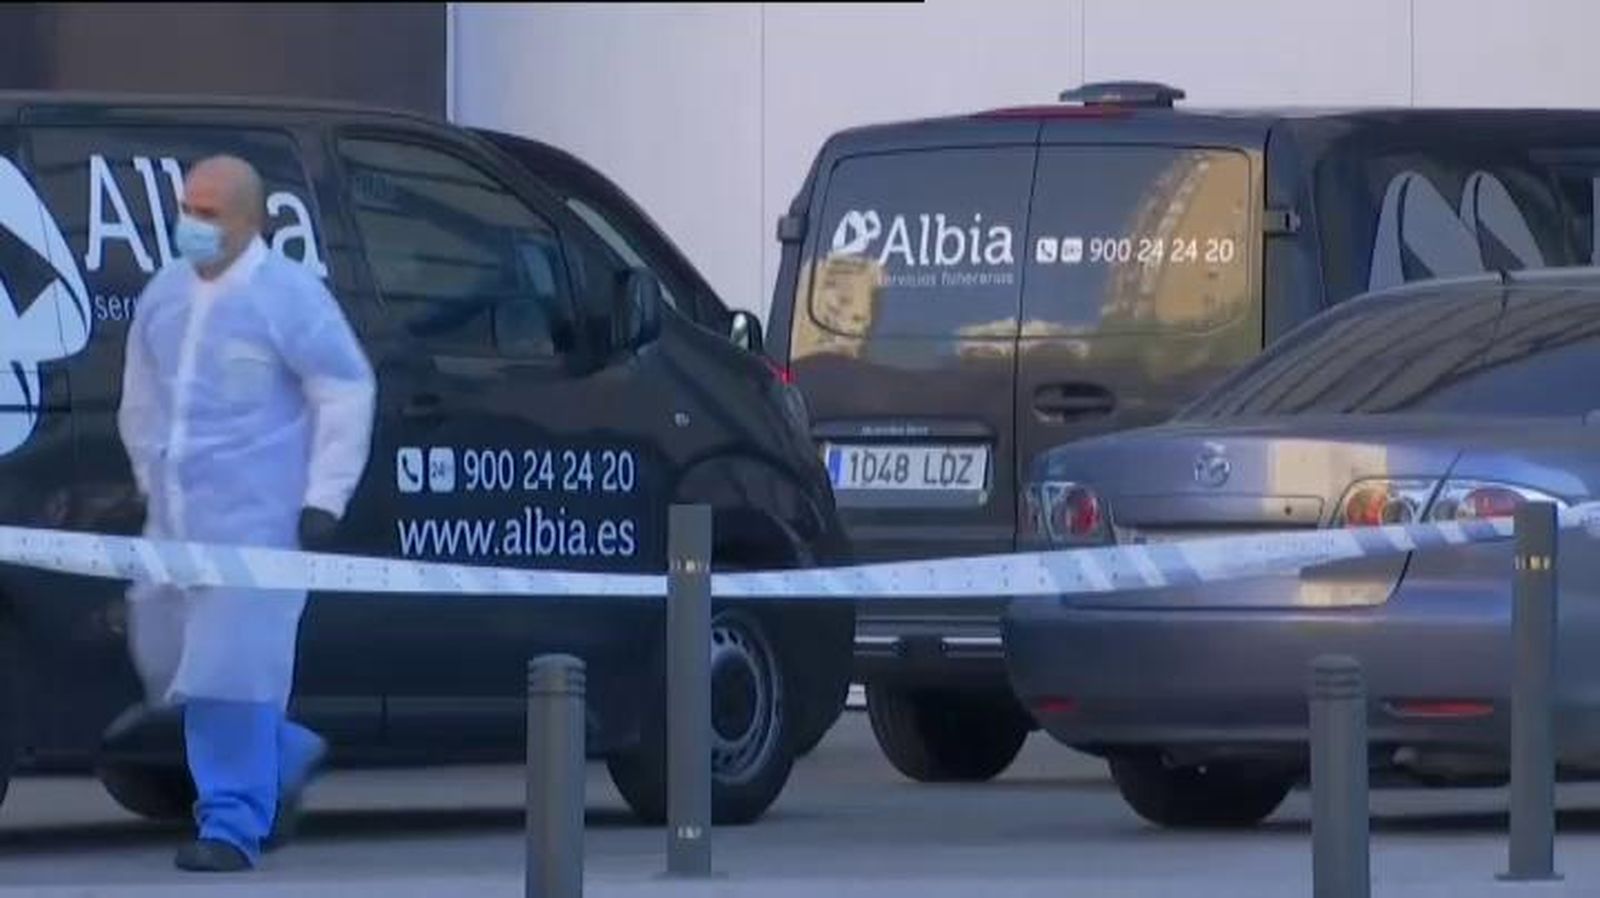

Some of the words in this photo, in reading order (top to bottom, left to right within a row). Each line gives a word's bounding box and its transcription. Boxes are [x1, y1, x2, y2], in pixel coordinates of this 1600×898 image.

[85, 154, 328, 278] Ala
[878, 212, 1014, 267] Albia
[1090, 238, 1131, 263] 900
[1137, 238, 1164, 263] 24
[1170, 238, 1198, 263] 24
[1205, 238, 1235, 263] 20
[463, 449, 514, 491] 900
[523, 450, 555, 491] 24
[562, 450, 594, 491] 24
[602, 450, 635, 492] 20
[850, 451, 910, 483] 1048
[398, 506, 635, 555] www.albia.es
